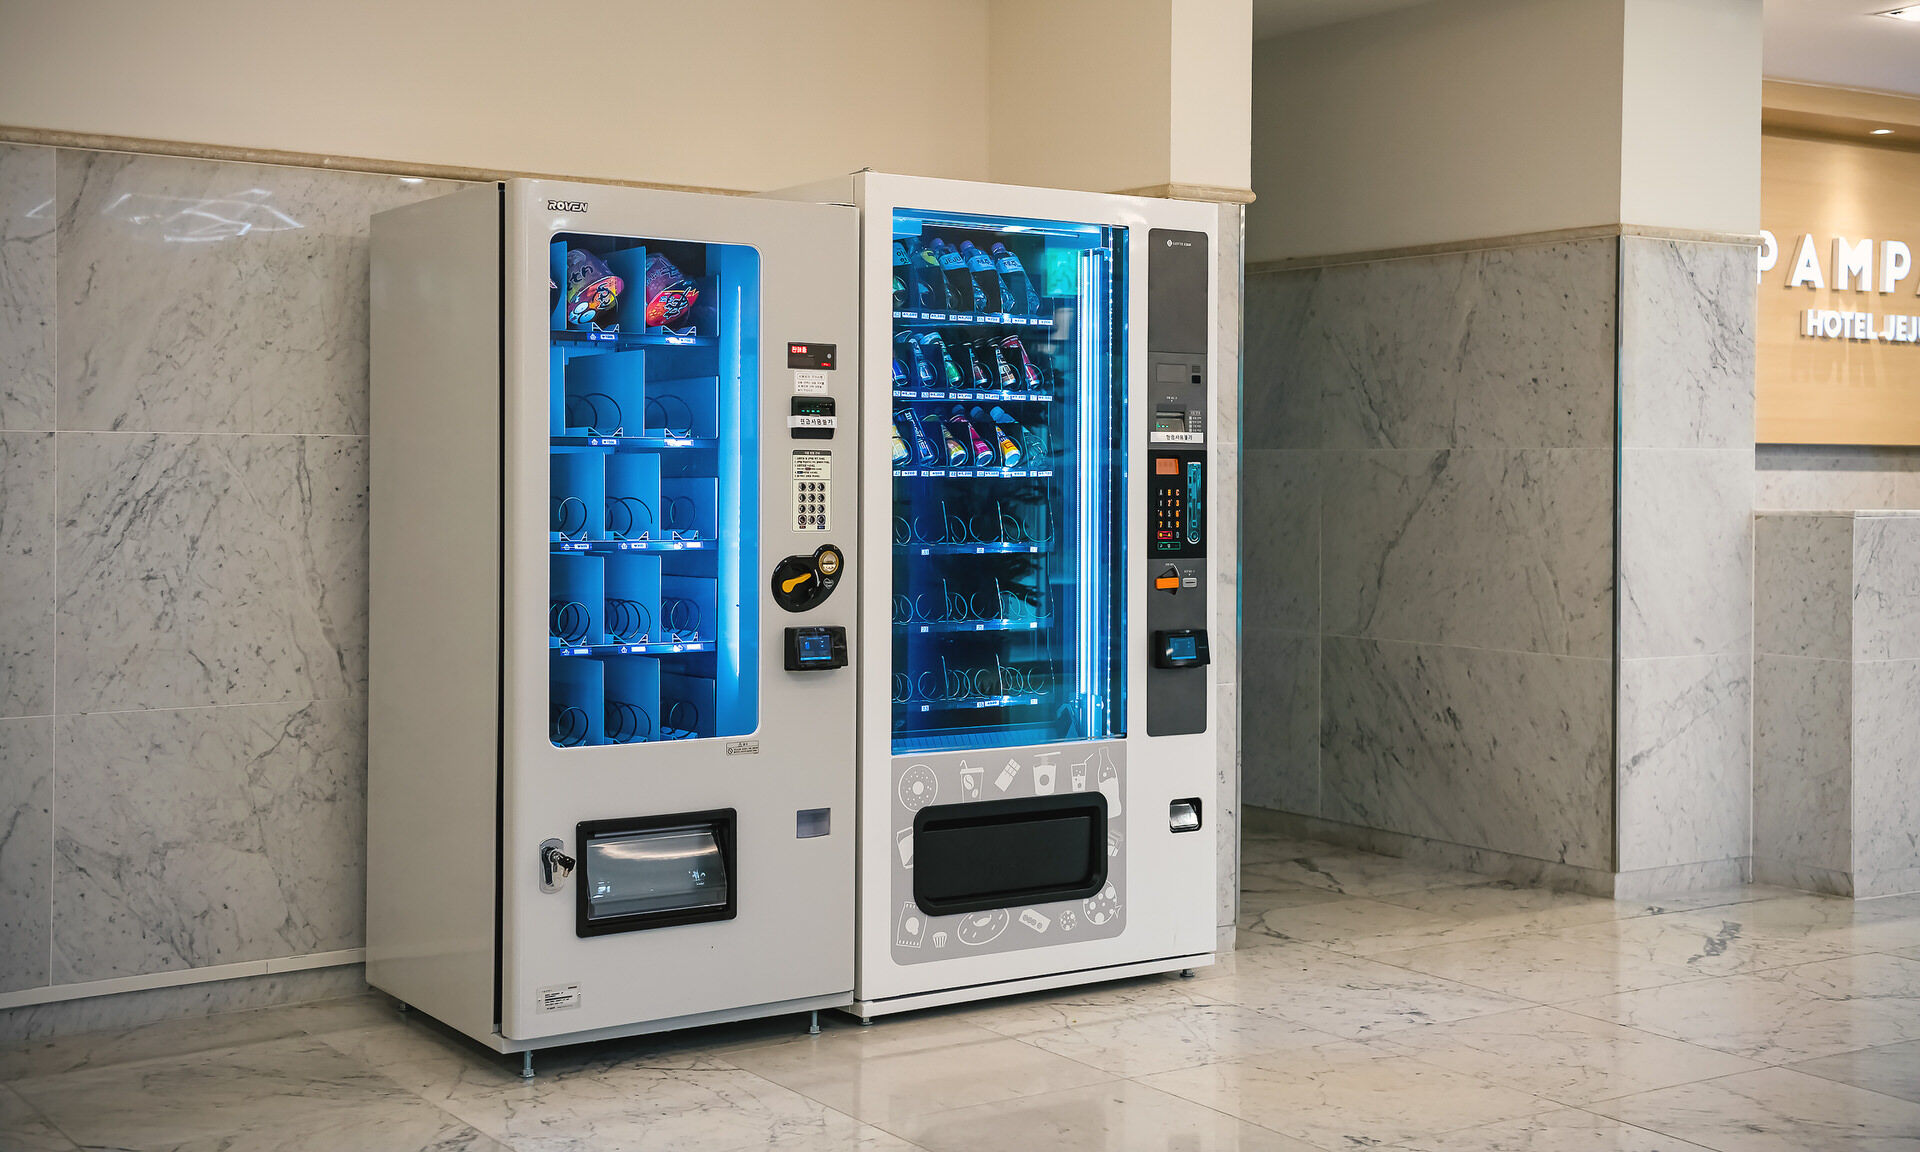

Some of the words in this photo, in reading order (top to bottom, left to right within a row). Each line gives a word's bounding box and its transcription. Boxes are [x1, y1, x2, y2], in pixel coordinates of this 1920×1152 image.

[548, 199, 588, 213] ROVEN
[944, 255, 962, 265] JEJU
[1757, 229, 1920, 296] PAMP
[1805, 308, 1878, 340] HOTEL
[1878, 314, 1920, 342] JEJ
